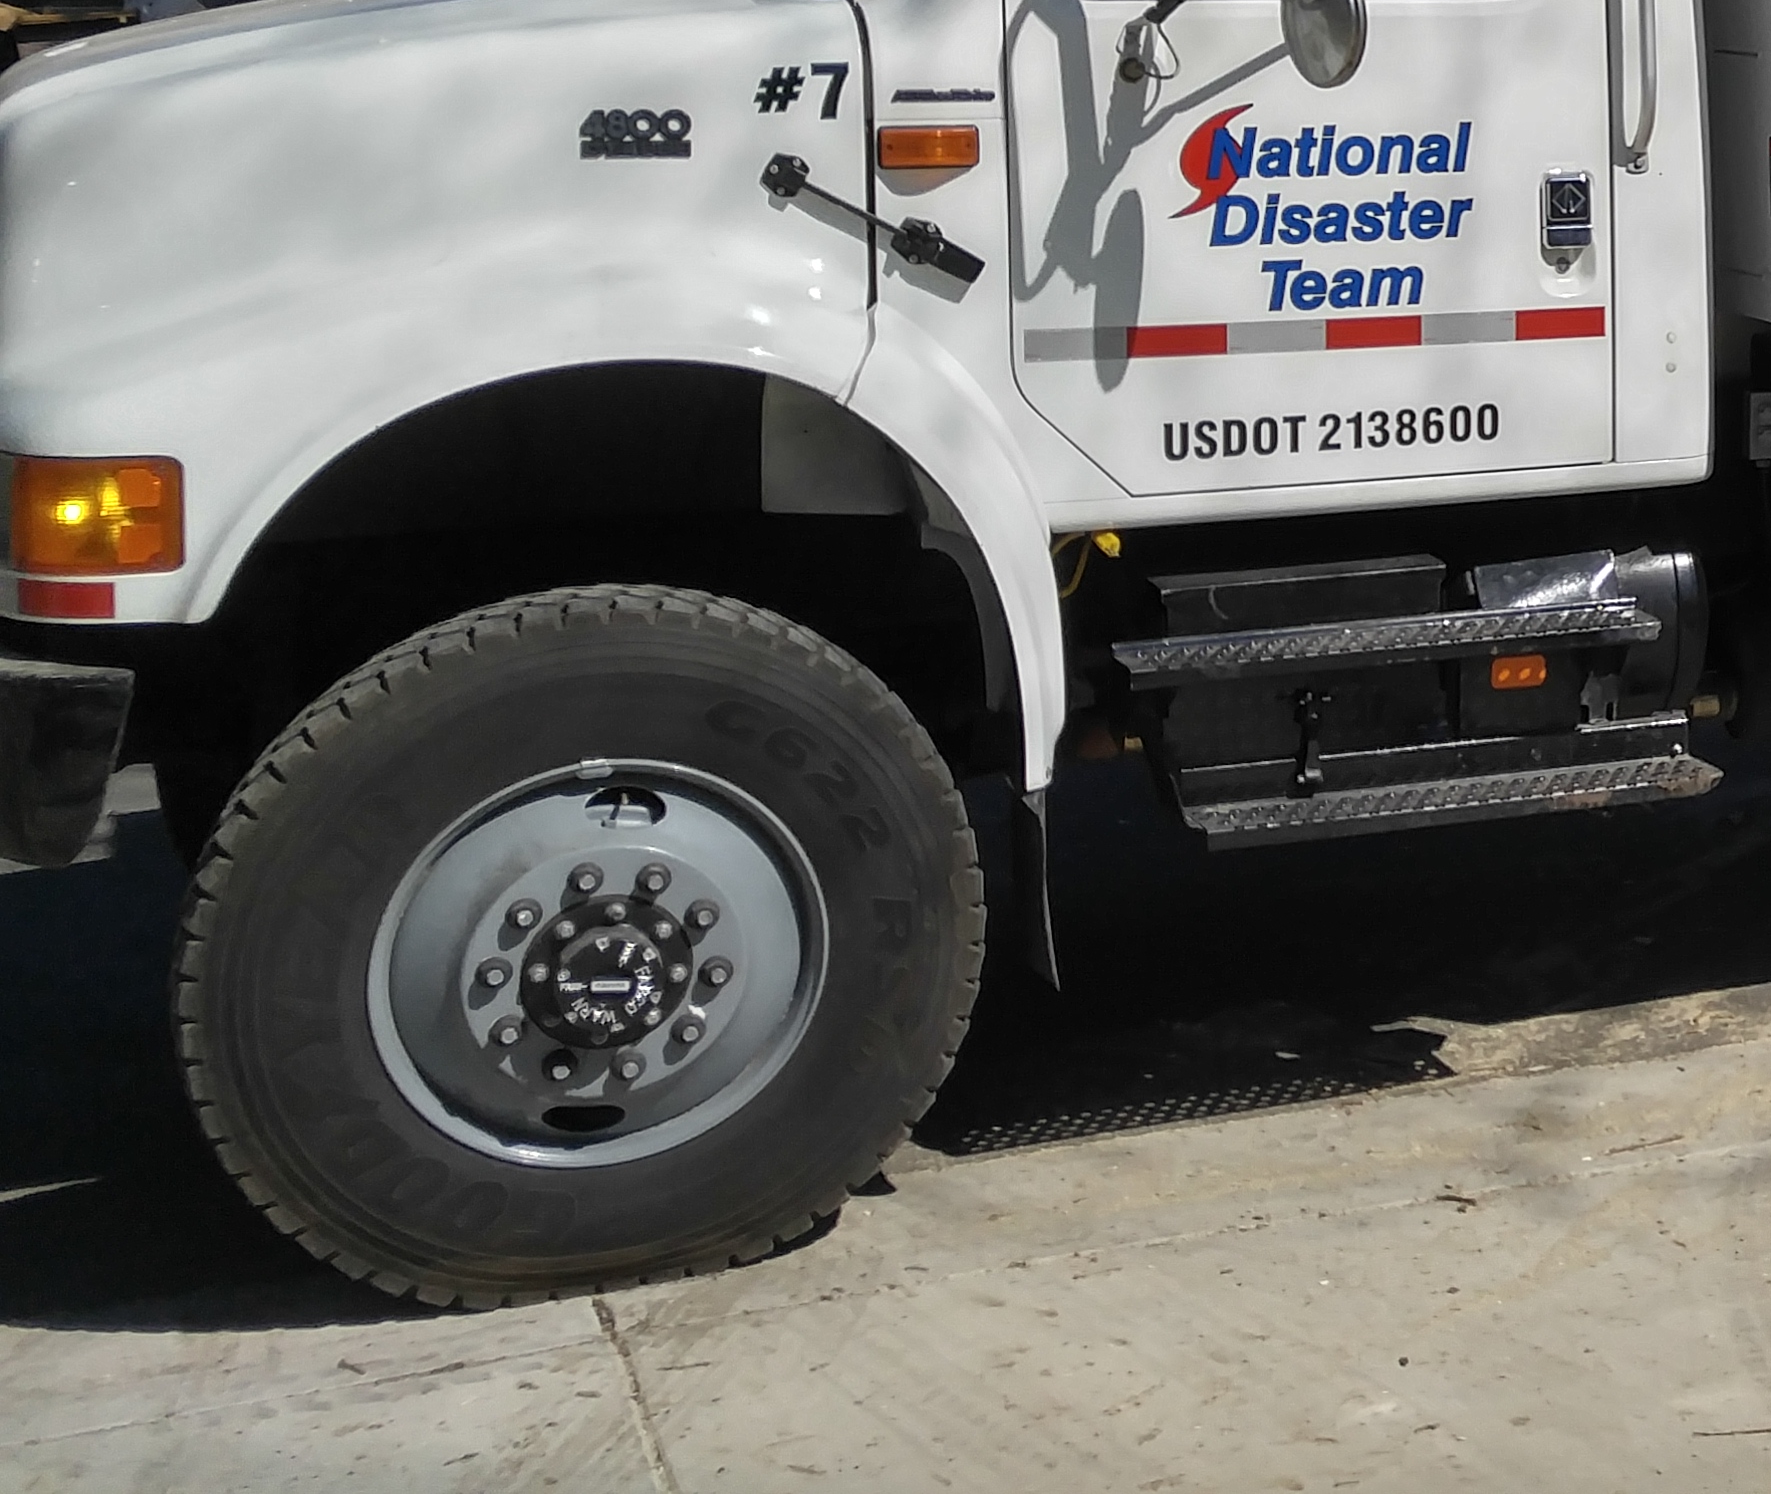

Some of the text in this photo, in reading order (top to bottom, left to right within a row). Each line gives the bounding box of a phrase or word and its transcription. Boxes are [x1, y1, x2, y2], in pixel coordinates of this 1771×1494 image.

[753, 61, 850, 120] #7
[578, 108, 692, 140] 4800
[1207, 122, 1472, 180] National
[1209, 191, 1474, 247] Disaster
[1261, 259, 1424, 311] Team
[1162, 403, 1499, 461] USDOT 2138600
[571, 997, 617, 1025] WARN
